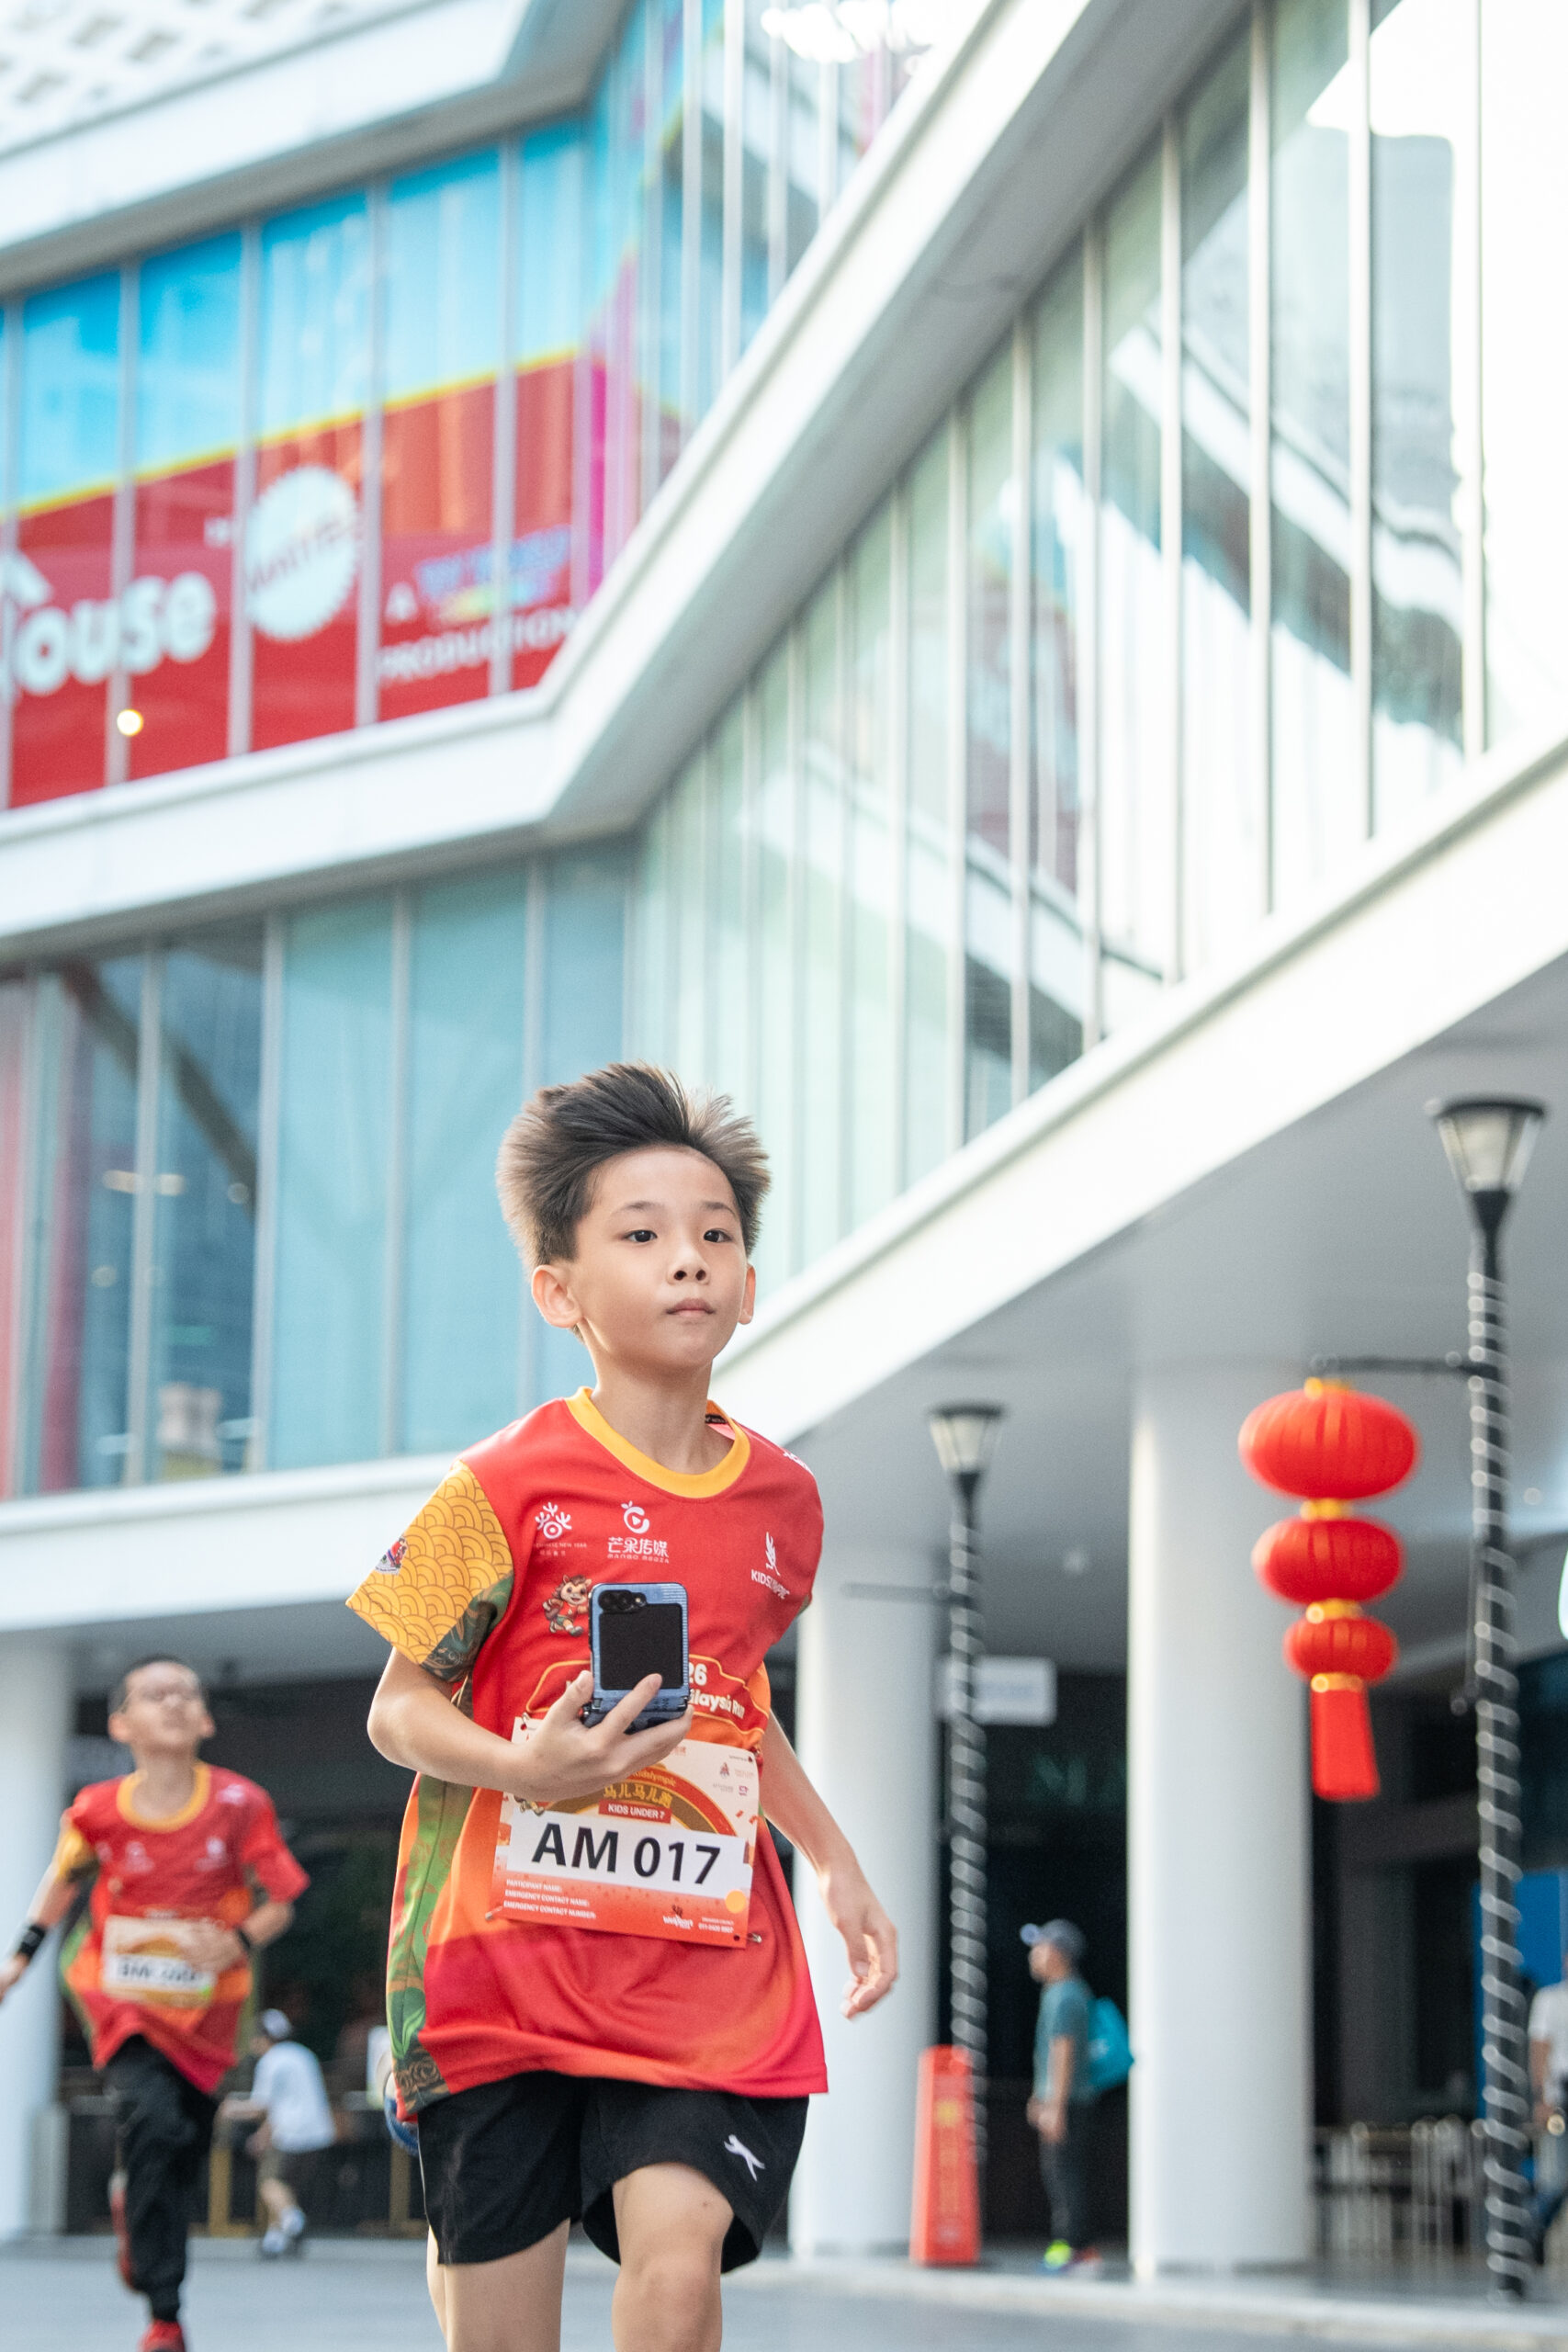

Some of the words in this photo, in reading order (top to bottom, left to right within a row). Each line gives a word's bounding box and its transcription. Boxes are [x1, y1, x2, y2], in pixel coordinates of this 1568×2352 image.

[607, 1536, 669, 1557] 芒果传媒
[608, 1804, 628, 1815] KIDS
[630, 1806, 659, 1819] UNDER
[531, 1822, 619, 1873] AM
[634, 1837, 720, 1884] 017
[504, 1889, 540, 1900] EMERGENCY
[541, 1894, 569, 1905] CONTACT
[503, 1900, 539, 1912] EMERGENCY
[539, 1905, 568, 1916] CONTACT
